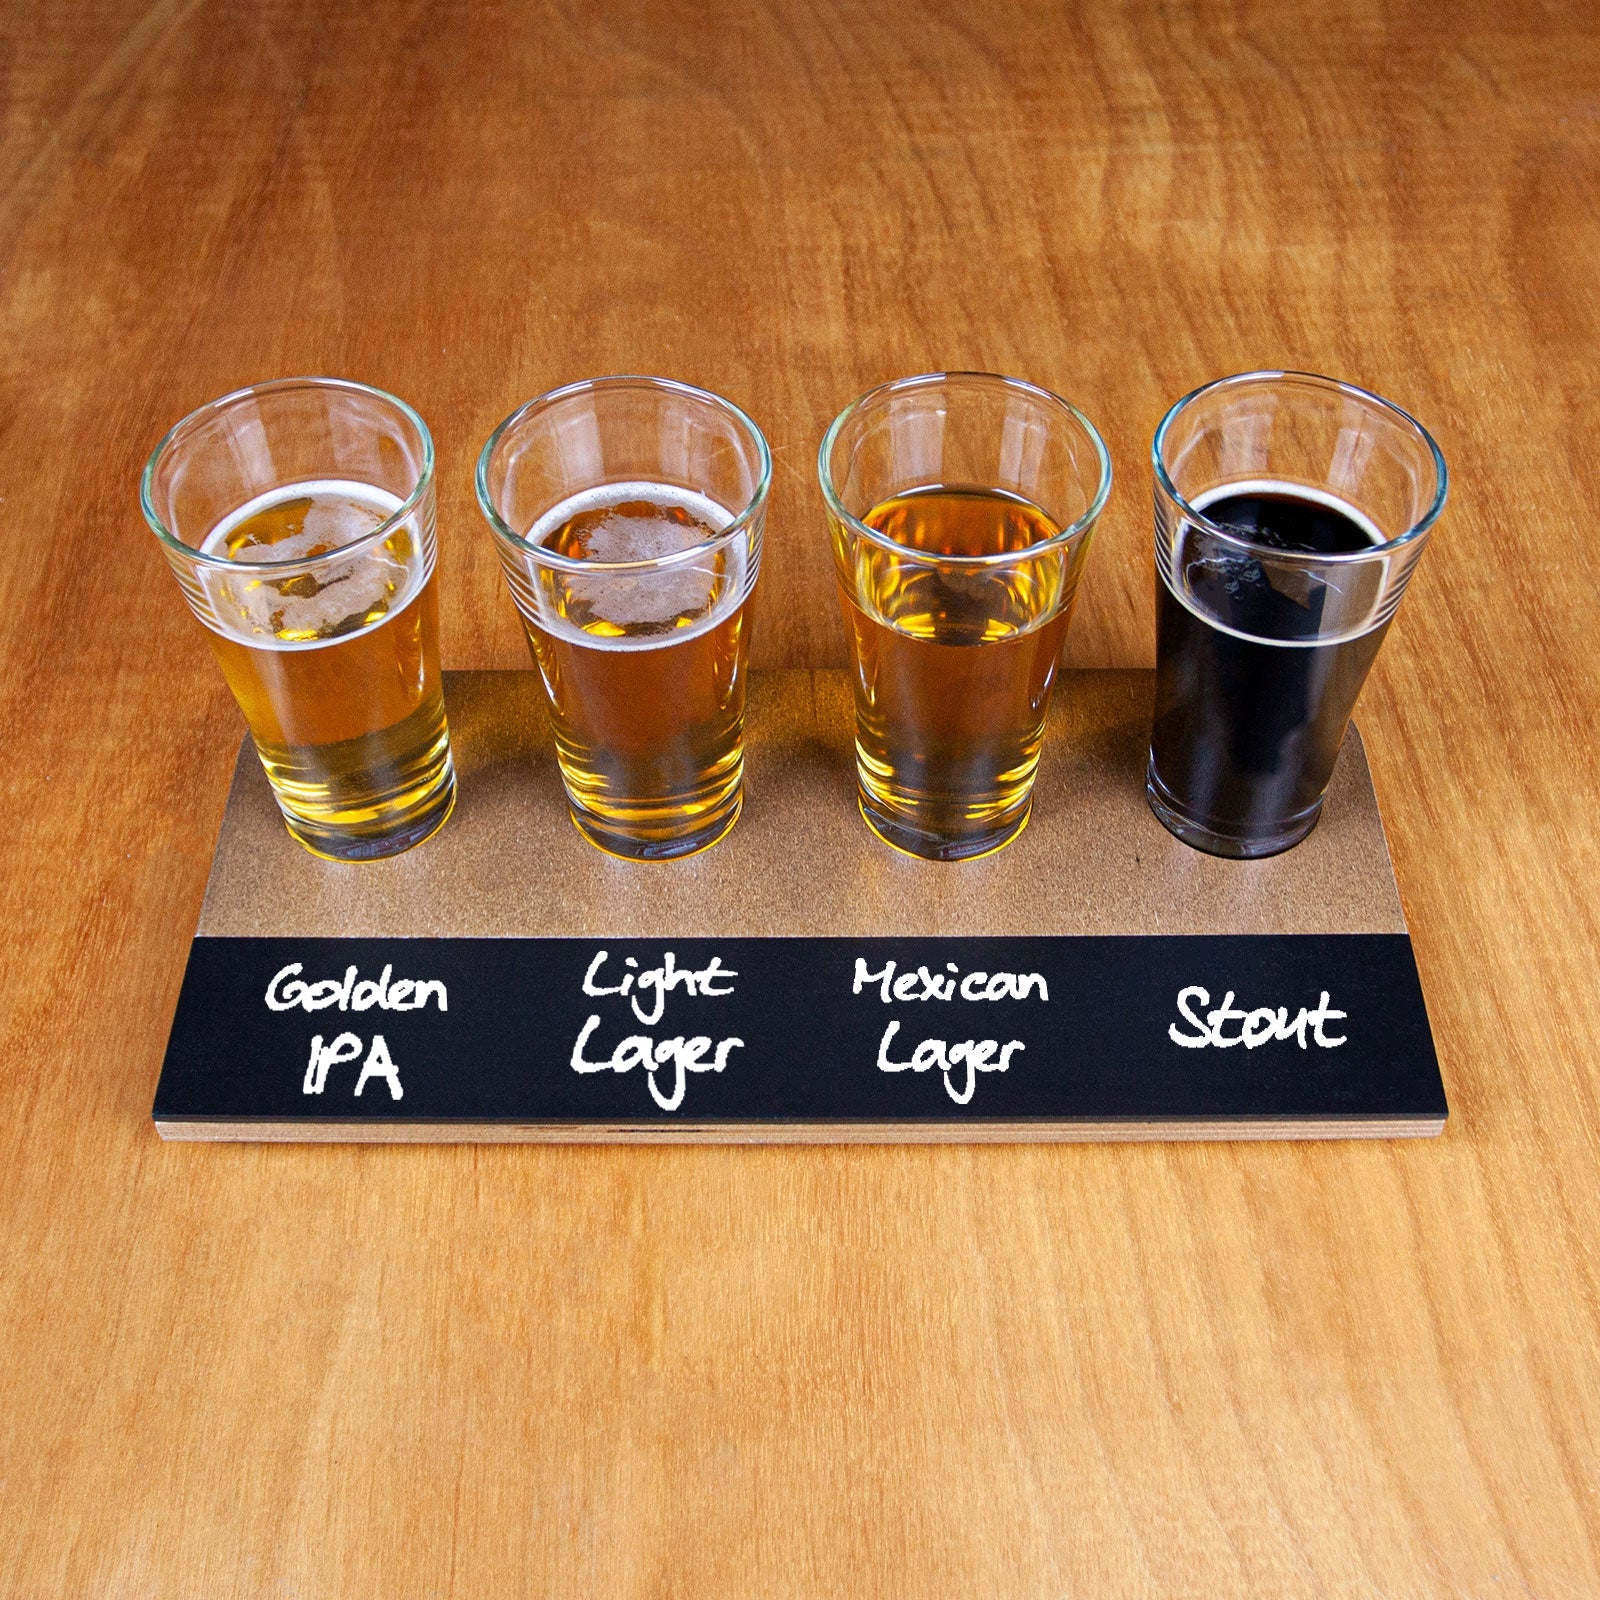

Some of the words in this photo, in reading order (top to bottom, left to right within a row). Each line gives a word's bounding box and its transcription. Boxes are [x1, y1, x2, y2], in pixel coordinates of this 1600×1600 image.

[265, 962, 448, 1013] Golden
[581, 951, 738, 1025] Light
[852, 957, 1049, 1003] Mexican
[1167, 985, 1348, 1050] Stout
[303, 1032, 404, 1101] IPA
[570, 1015, 745, 1111] Lager
[876, 1020, 1026, 1105] Lager
